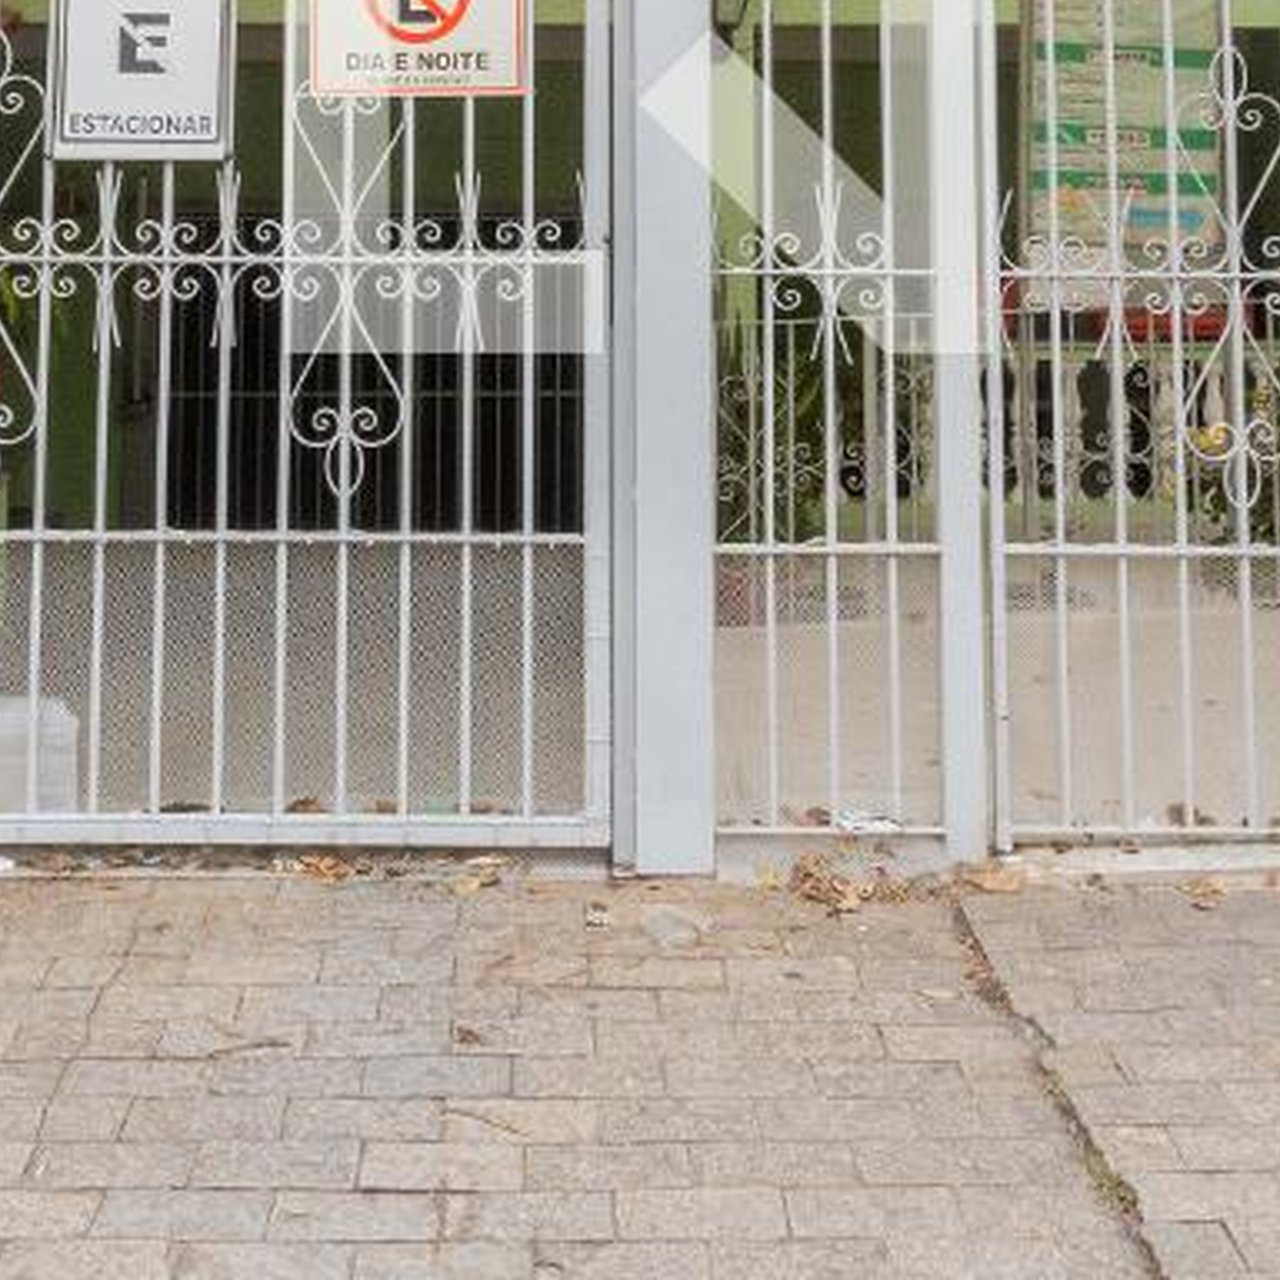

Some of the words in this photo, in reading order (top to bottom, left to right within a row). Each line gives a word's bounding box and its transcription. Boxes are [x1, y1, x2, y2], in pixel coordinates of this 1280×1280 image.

[345, 51, 385, 71] DIA
[395, 51, 409, 71] E
[416, 51, 490, 71] NOITE
[68, 112, 213, 136] ESTACIONAR
